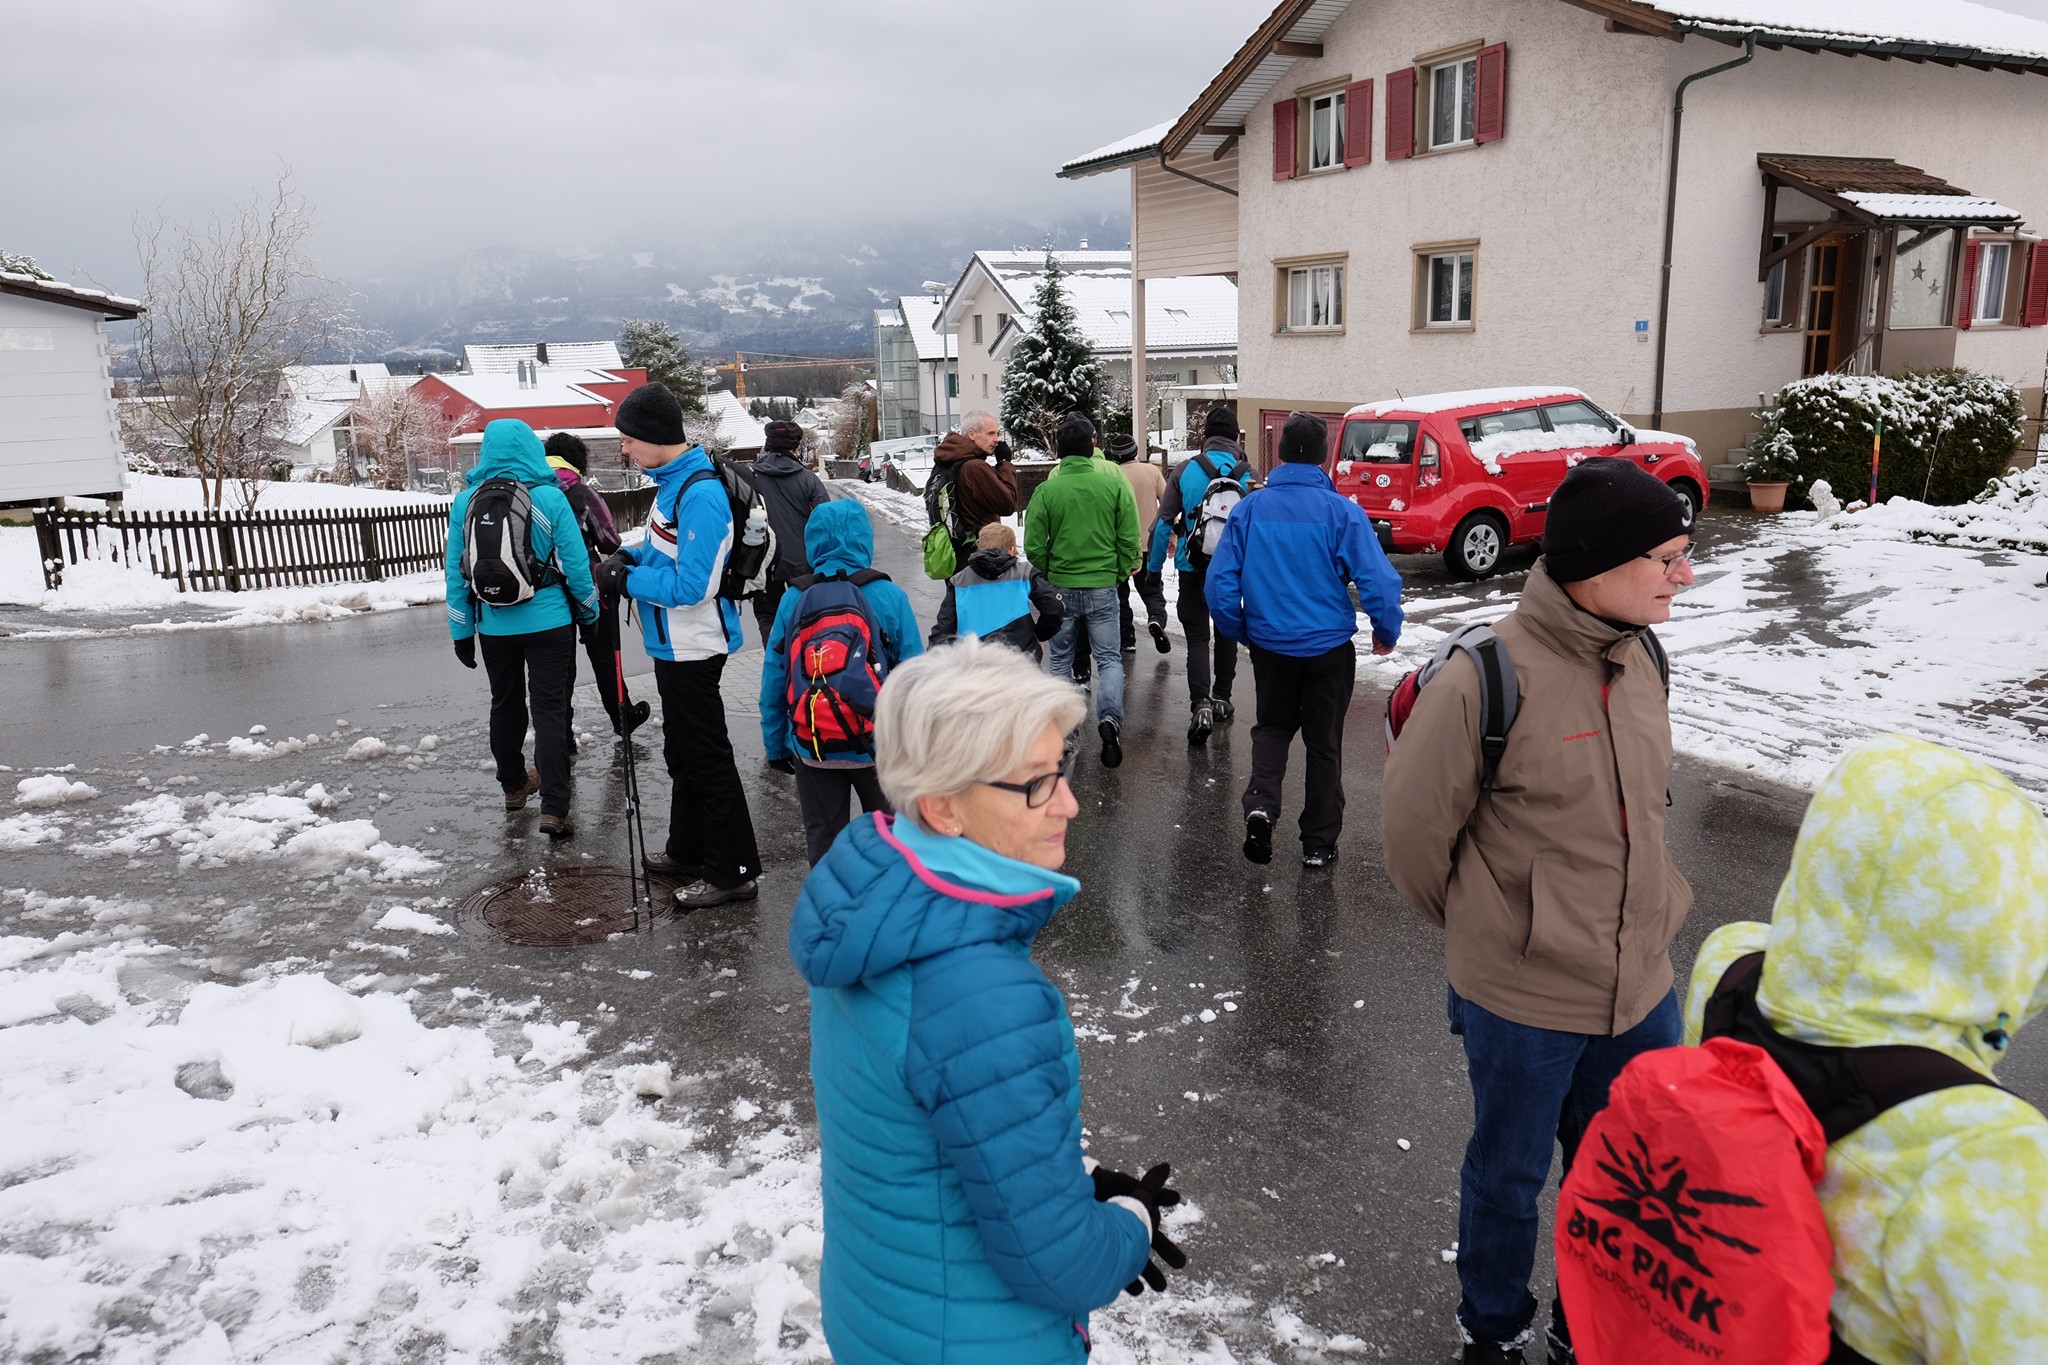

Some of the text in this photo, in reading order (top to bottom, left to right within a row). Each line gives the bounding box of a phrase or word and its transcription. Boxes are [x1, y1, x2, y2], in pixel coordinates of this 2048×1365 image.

[1378, 476, 1388, 486] CH
[1568, 1208, 1725, 1334] BIG PACK
[1652, 1311, 1724, 1360] COMPANY
